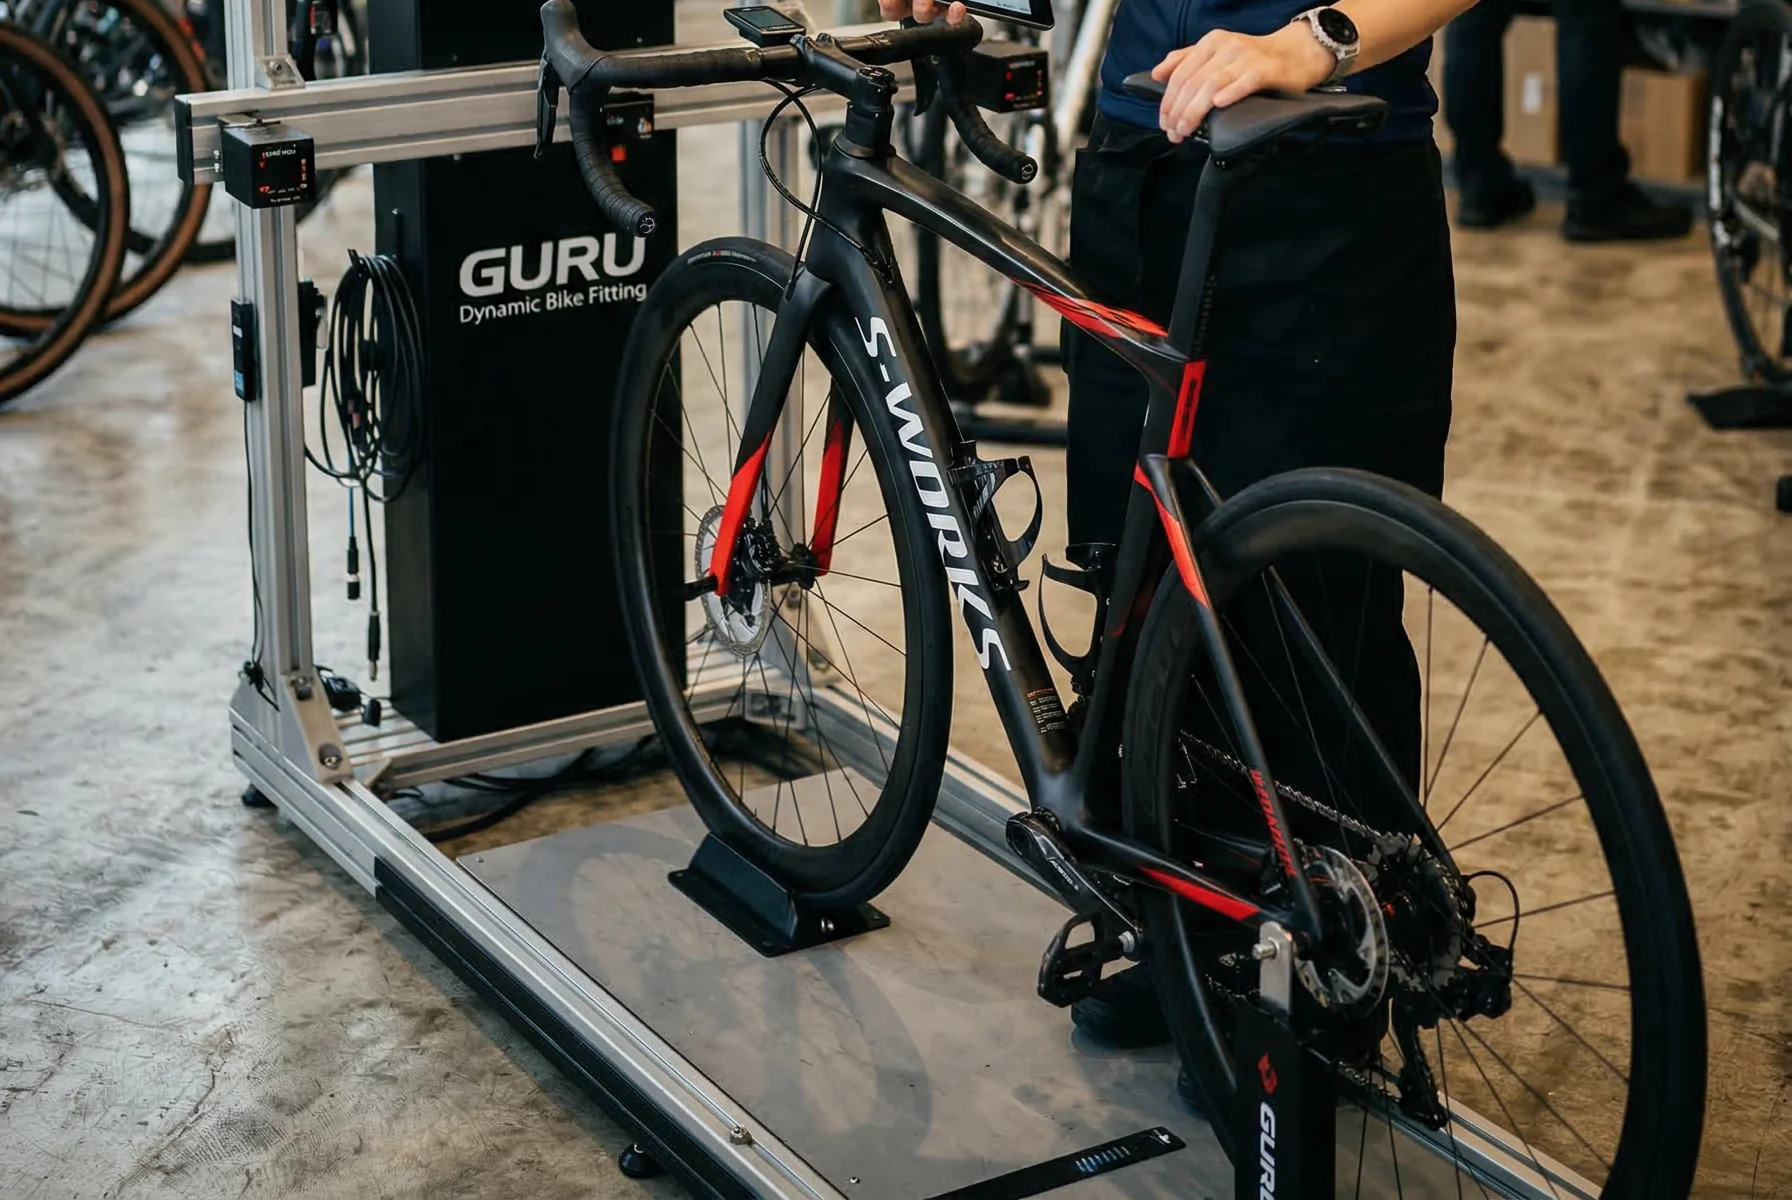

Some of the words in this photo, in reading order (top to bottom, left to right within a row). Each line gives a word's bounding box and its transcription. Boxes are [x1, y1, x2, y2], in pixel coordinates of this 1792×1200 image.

[459, 233, 646, 298] GURU
[459, 296, 542, 325] Dynamic
[546, 290, 584, 311] Bike
[588, 283, 647, 305] Fitting
[855, 316, 1012, 672] S-WORKS
